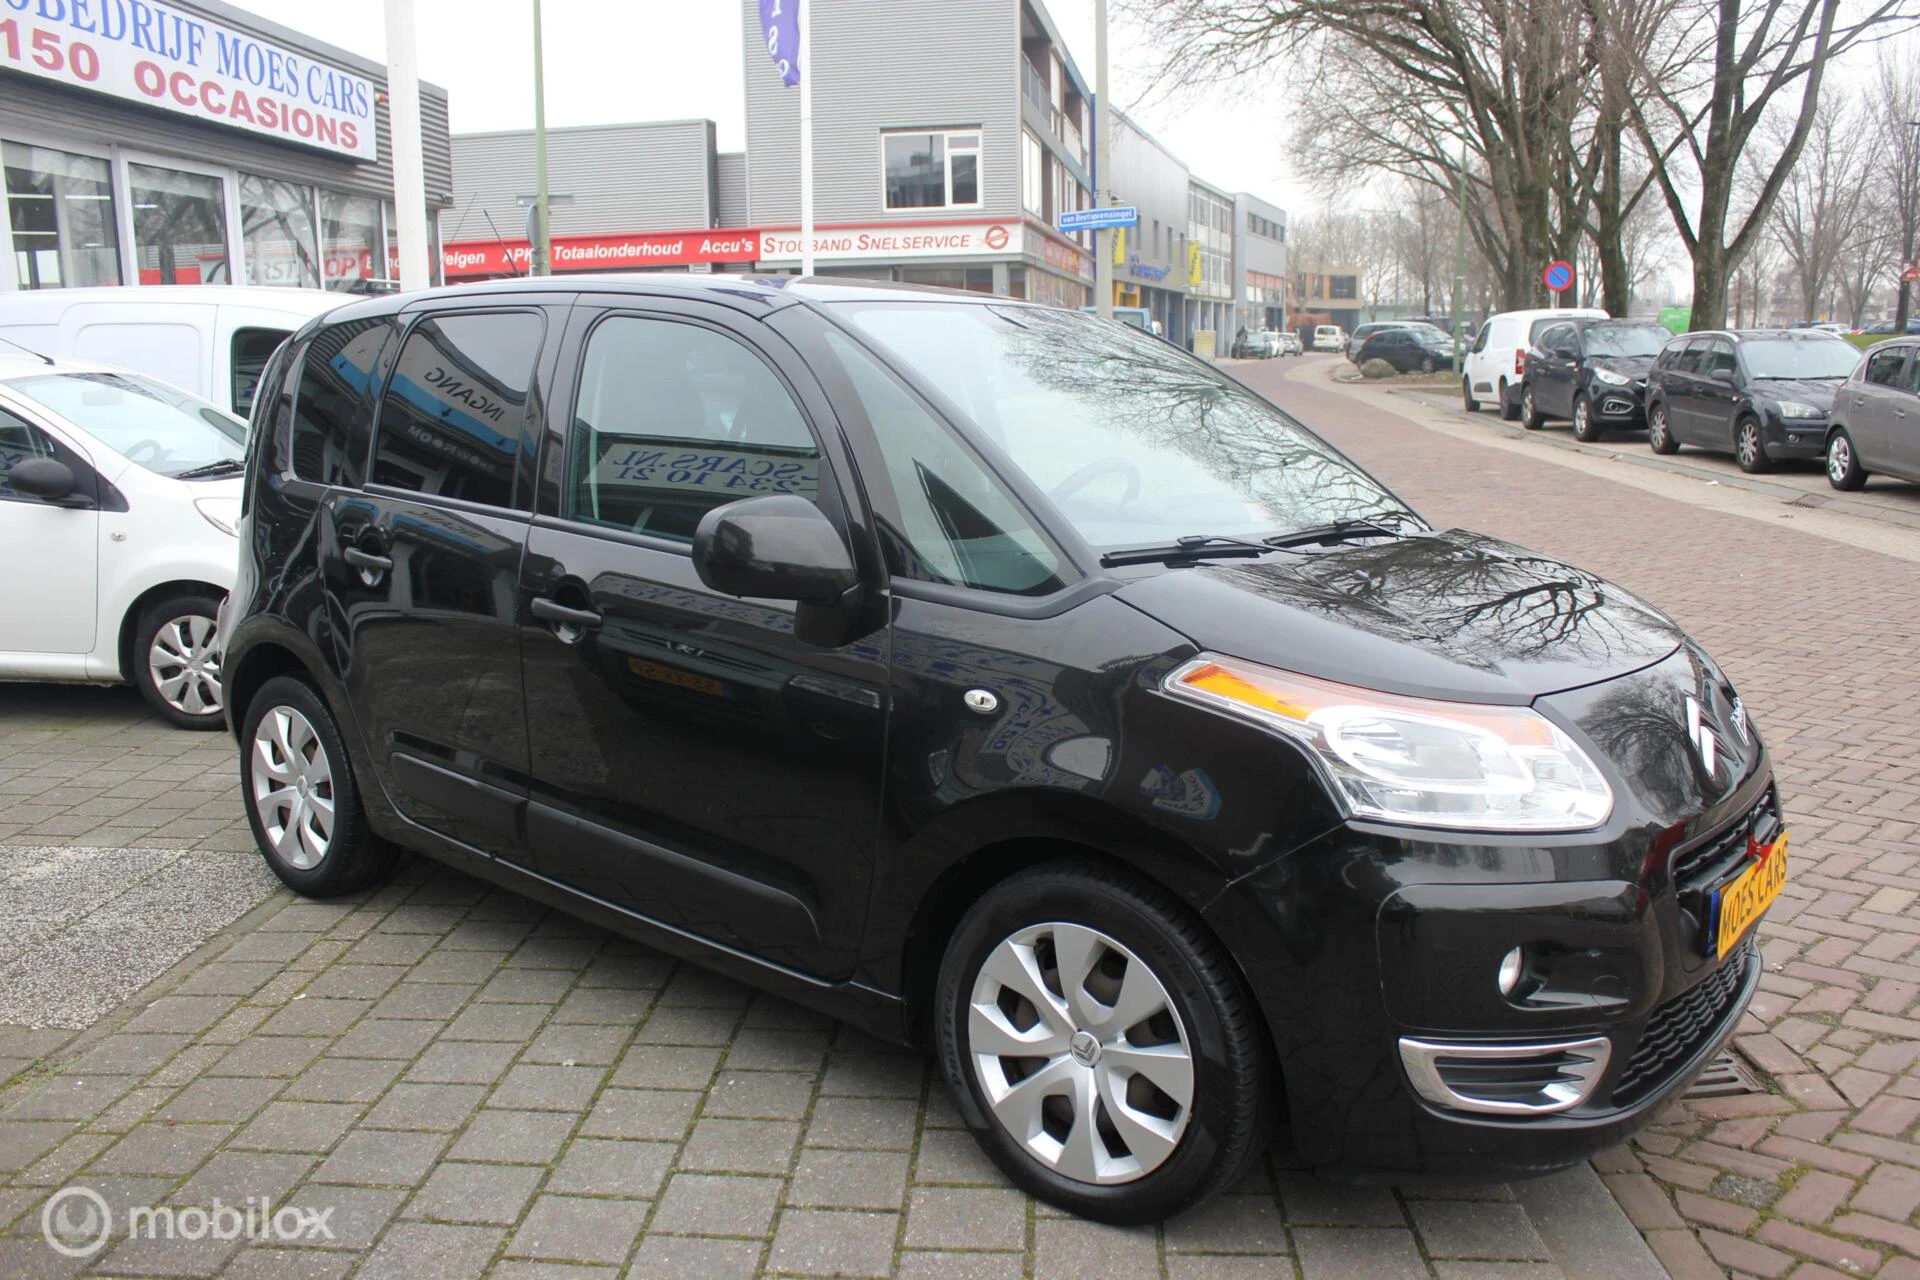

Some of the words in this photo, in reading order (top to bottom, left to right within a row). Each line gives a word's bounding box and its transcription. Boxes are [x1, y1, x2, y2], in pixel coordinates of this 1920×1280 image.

[0, 18, 100, 82] 150
[134, 60, 358, 149] OCCASIONS
[216, 32, 300, 97] MOES
[307, 64, 369, 119] CARS
[554, 240, 683, 260] Totaalonderhoud
[700, 237, 754, 254] Accu's
[857, 234, 971, 250] SNELSERVICE
[1758, 840, 1789, 902] CARS
